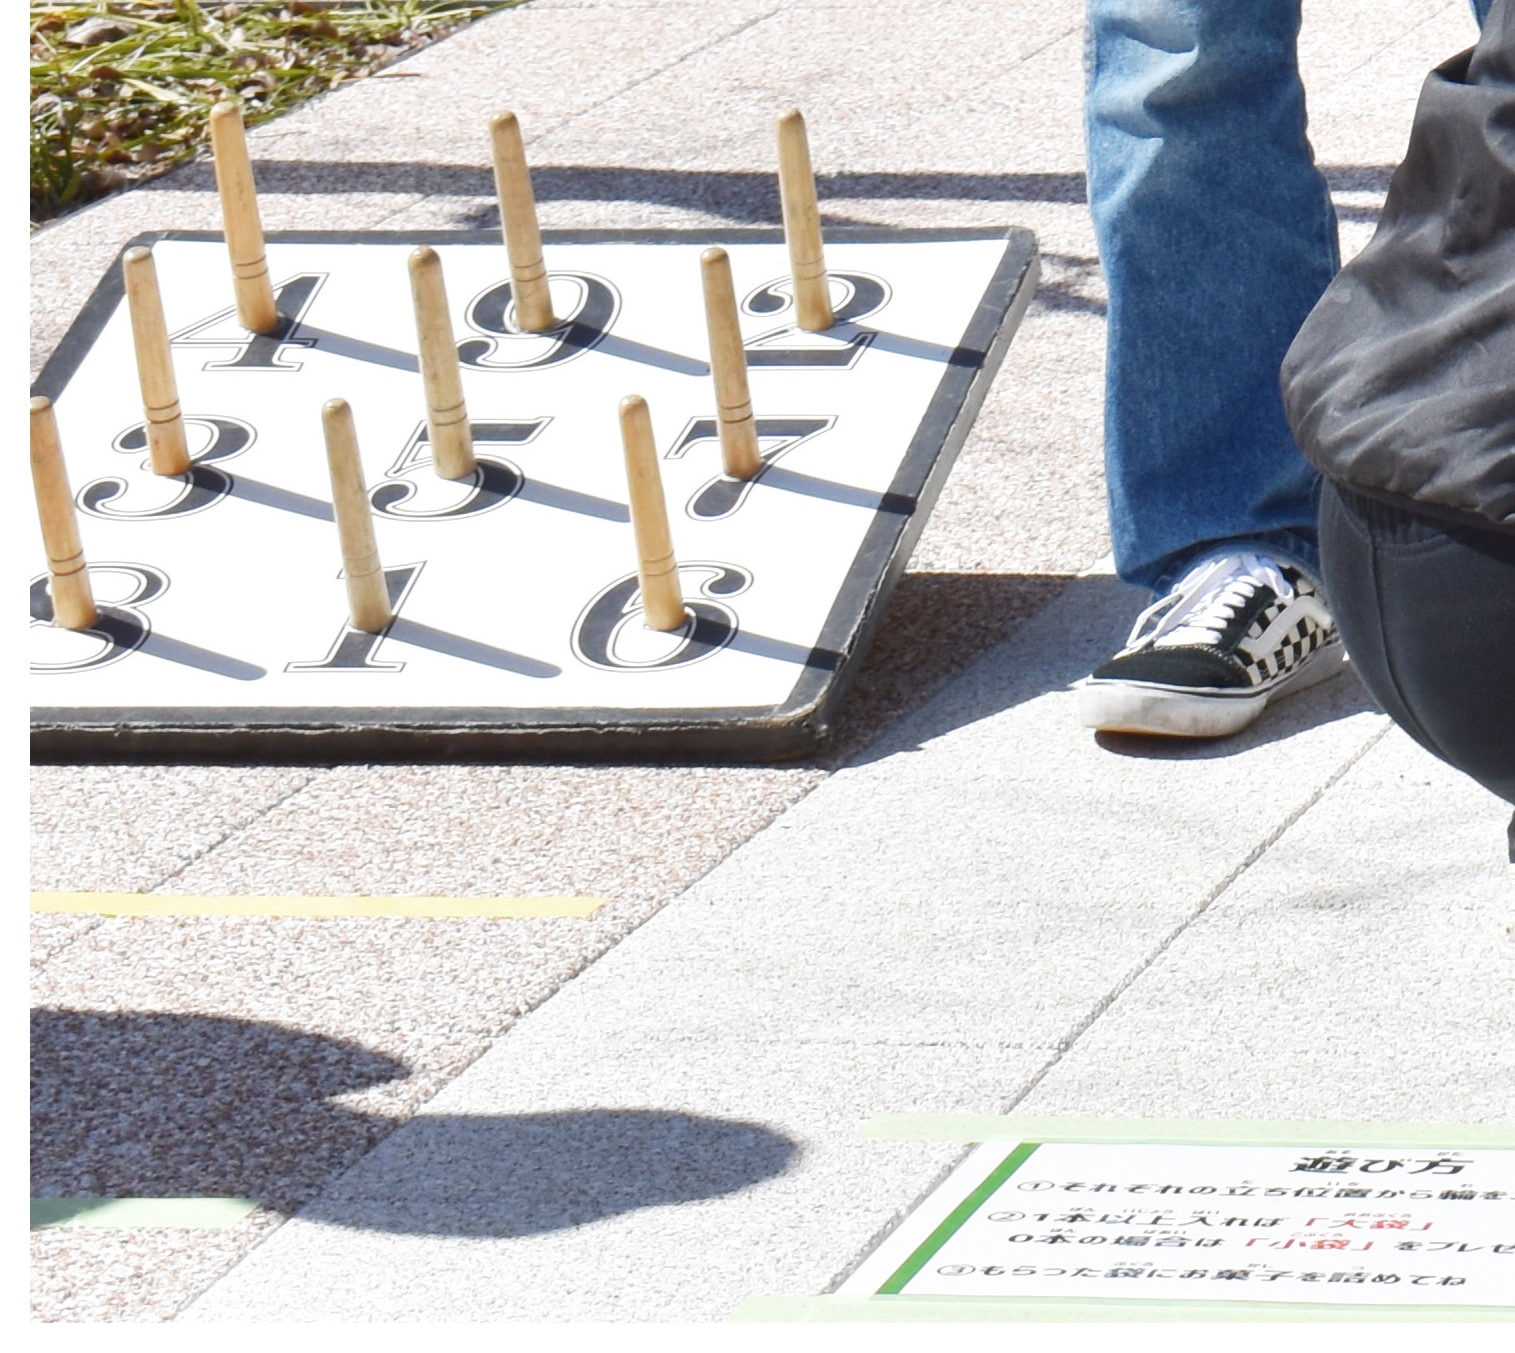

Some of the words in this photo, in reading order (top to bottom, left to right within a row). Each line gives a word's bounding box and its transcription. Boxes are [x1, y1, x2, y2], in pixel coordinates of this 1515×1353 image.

[169, 271, 330, 372] 4
[457, 270, 622, 372] 9
[741, 270, 892, 371] 2
[77, 415, 257, 521] 3
[367, 417, 551, 521] 5
[666, 415, 836, 521] 7
[284, 560, 427, 673] 1
[570, 561, 754, 673] 6
[1289, 1156, 1475, 1175] 遊び方
